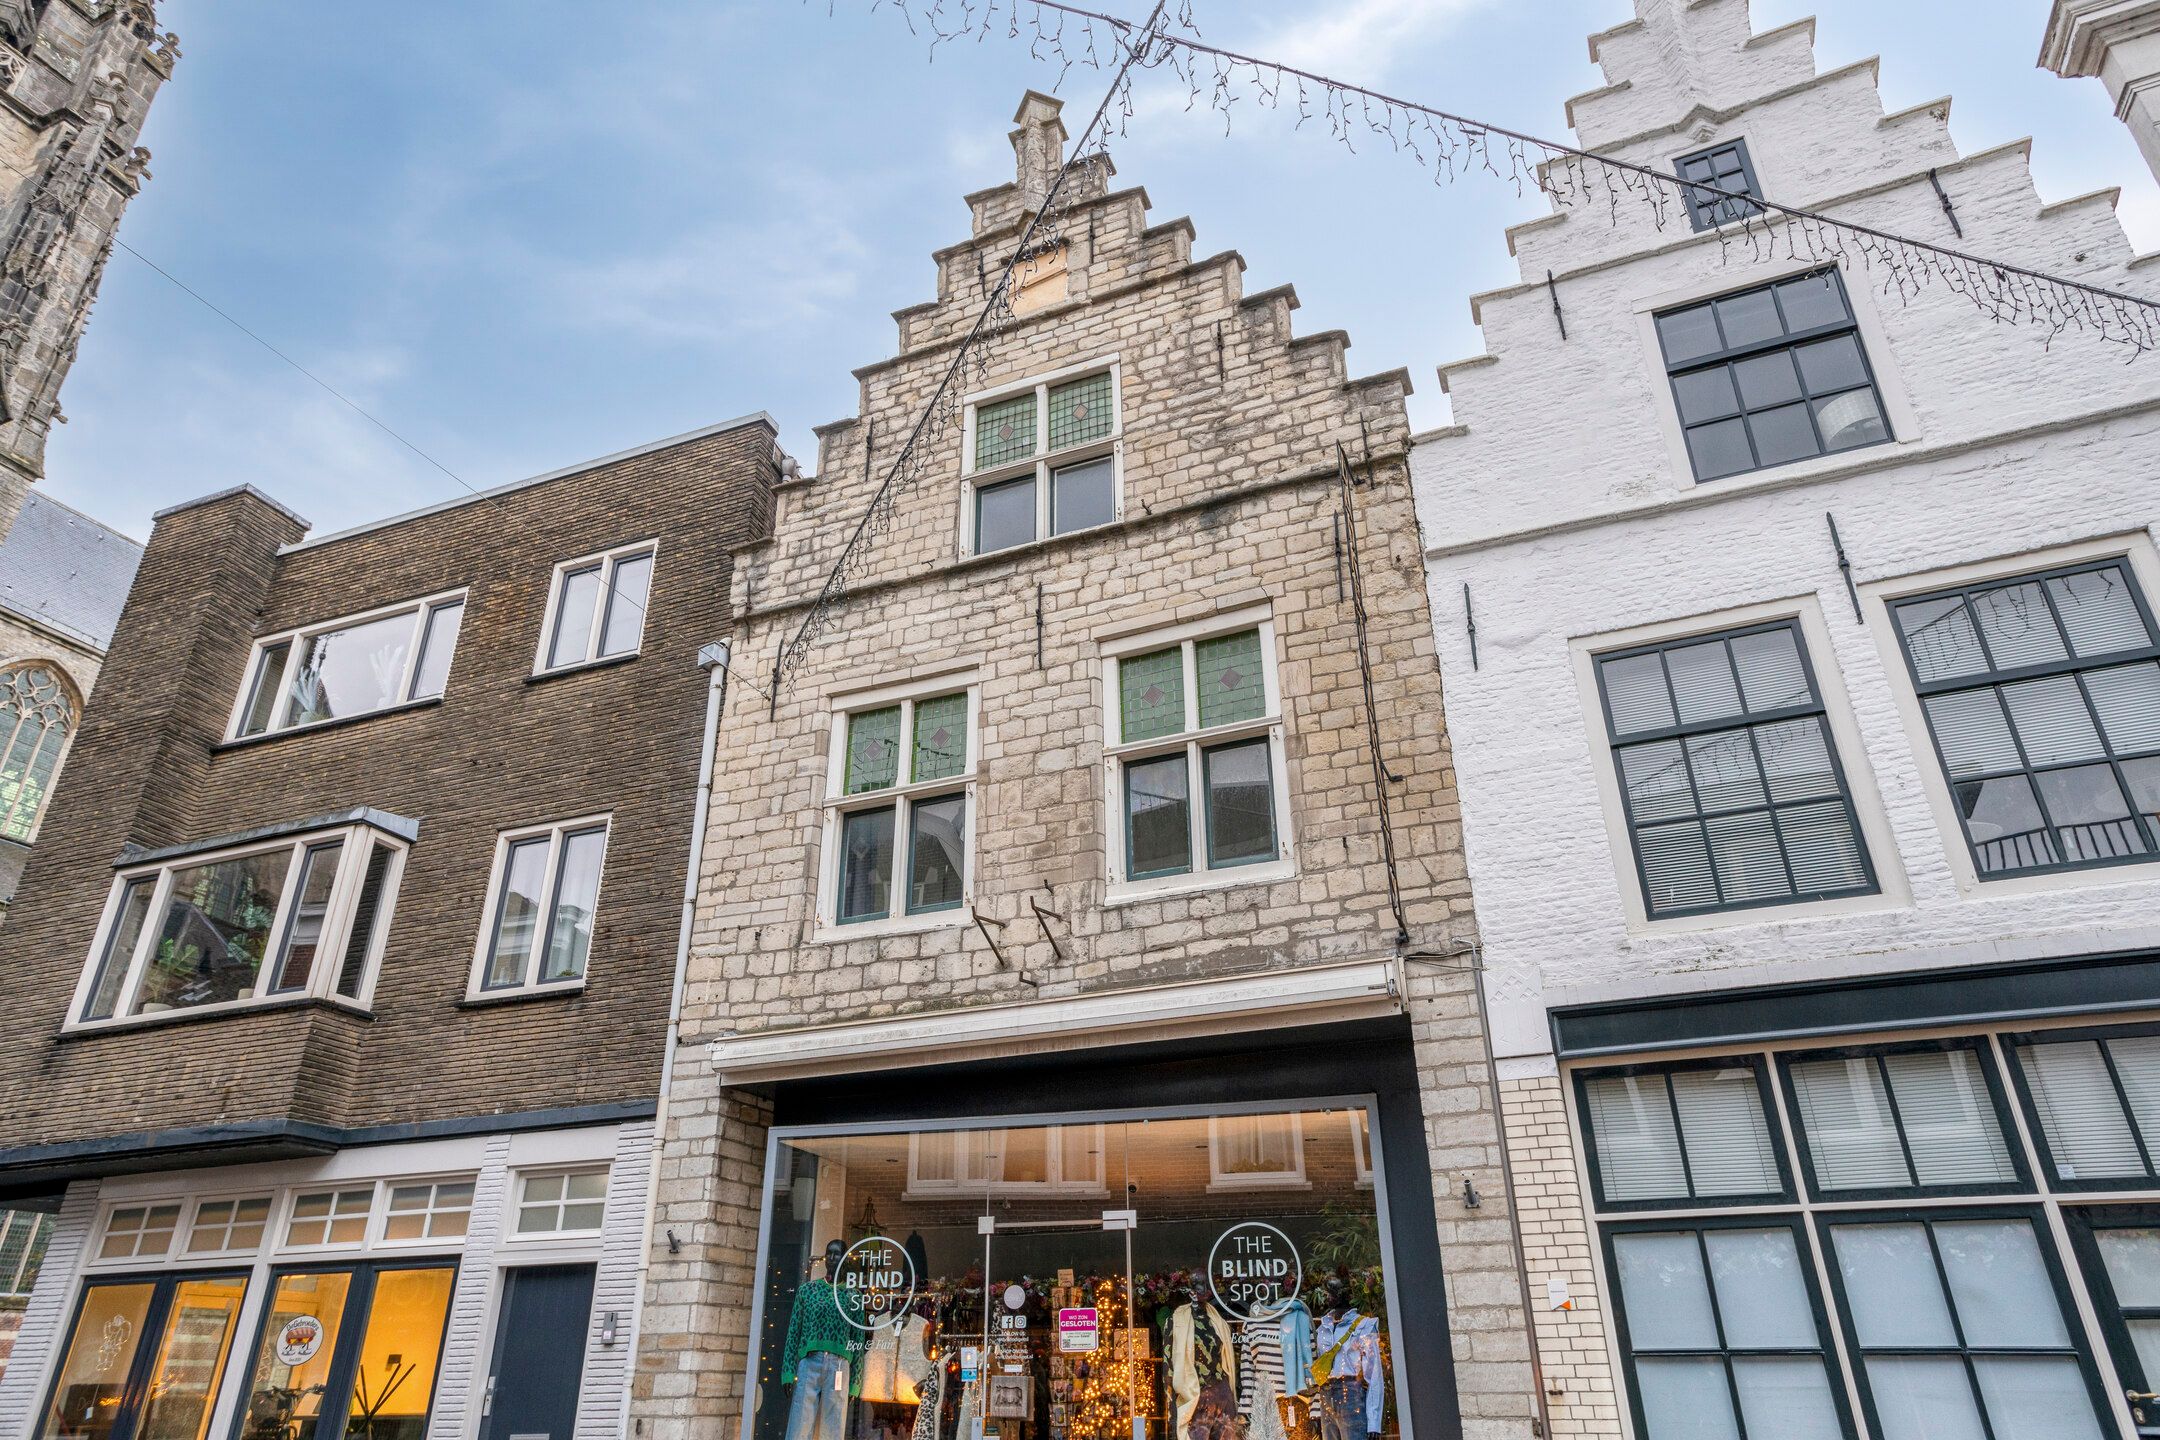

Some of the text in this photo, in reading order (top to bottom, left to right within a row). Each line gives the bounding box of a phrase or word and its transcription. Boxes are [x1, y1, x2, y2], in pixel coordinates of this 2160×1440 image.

[1233, 1235, 1272, 1253] THE
[859, 1249, 892, 1266] THE
[1221, 1258, 1288, 1278] BLIND
[846, 1270, 904, 1289] BLIND
[1230, 1282, 1282, 1301] SPOT
[850, 1293, 896, 1311] SPOT
[845, 1340, 863, 1350] Eco
[864, 1339, 875, 1350] &
